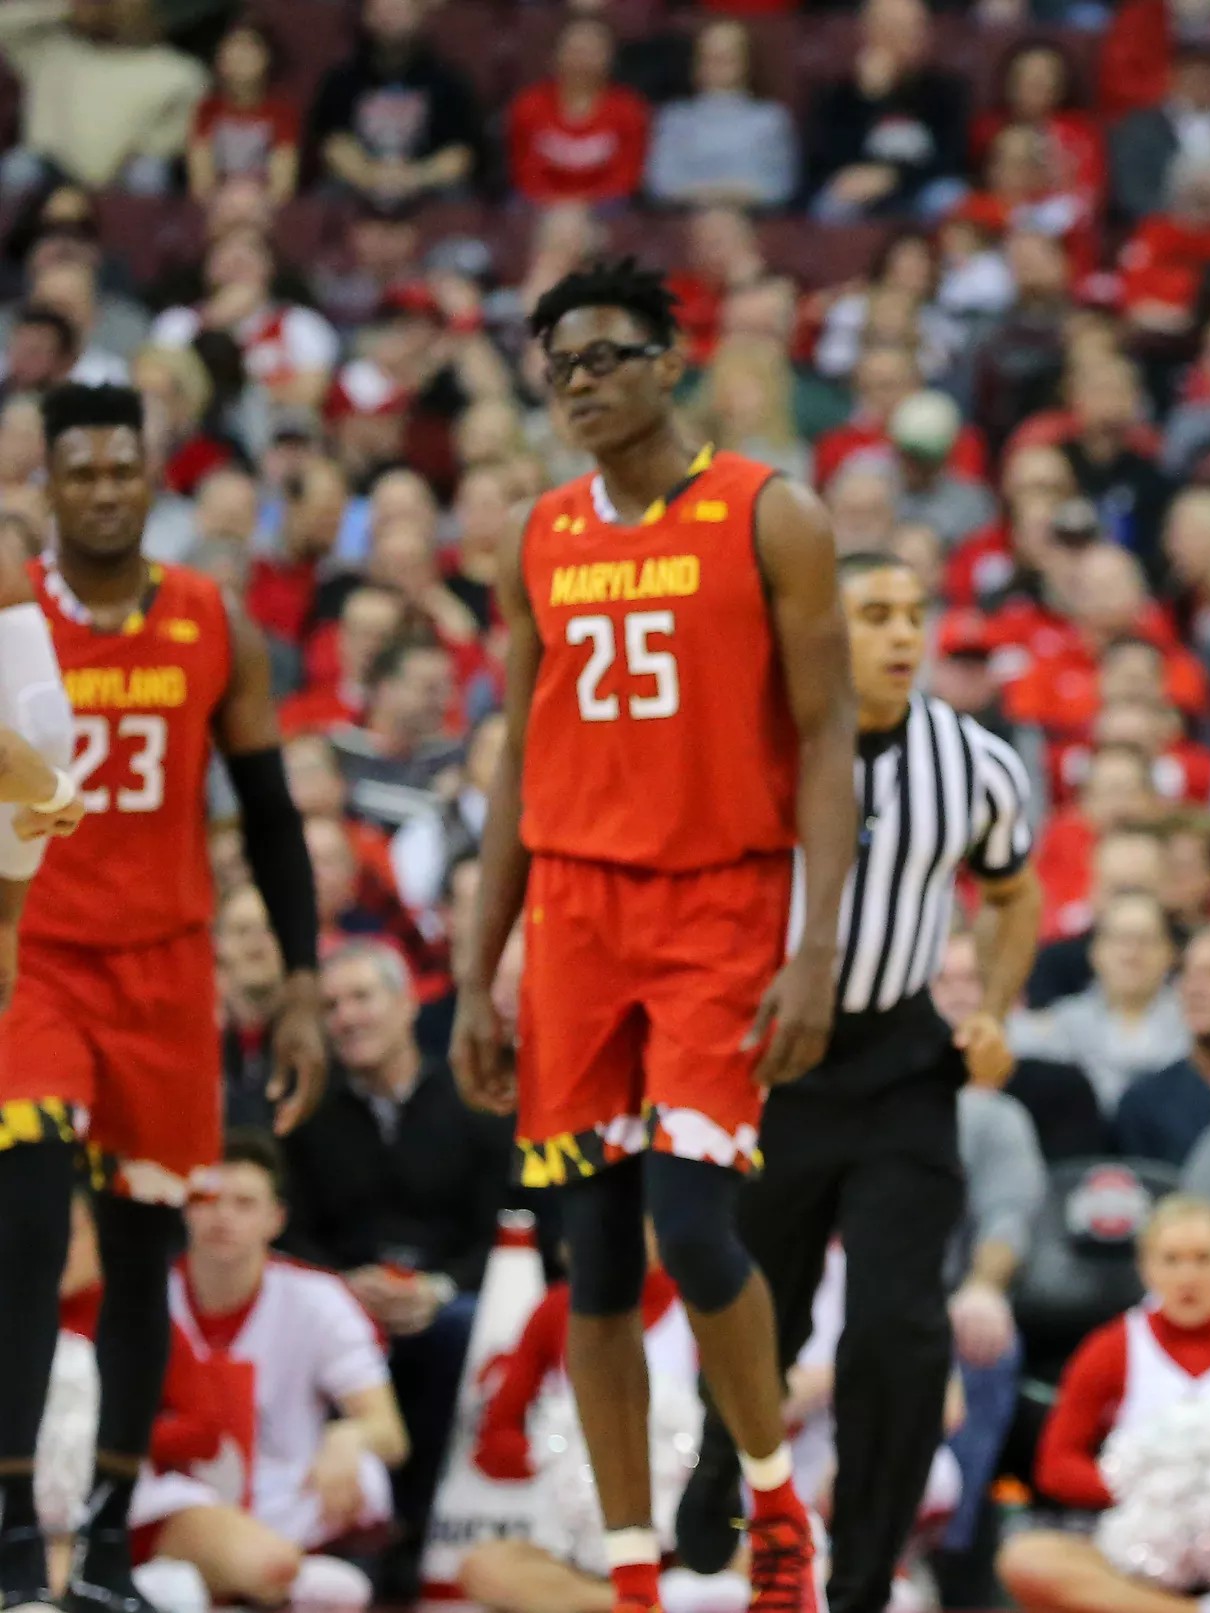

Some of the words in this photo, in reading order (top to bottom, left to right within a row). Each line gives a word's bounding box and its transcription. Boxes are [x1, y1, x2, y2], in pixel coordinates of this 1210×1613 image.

[550, 554, 700, 607] MARYLAND
[565, 610, 680, 722] 25
[70, 713, 169, 813] 23
